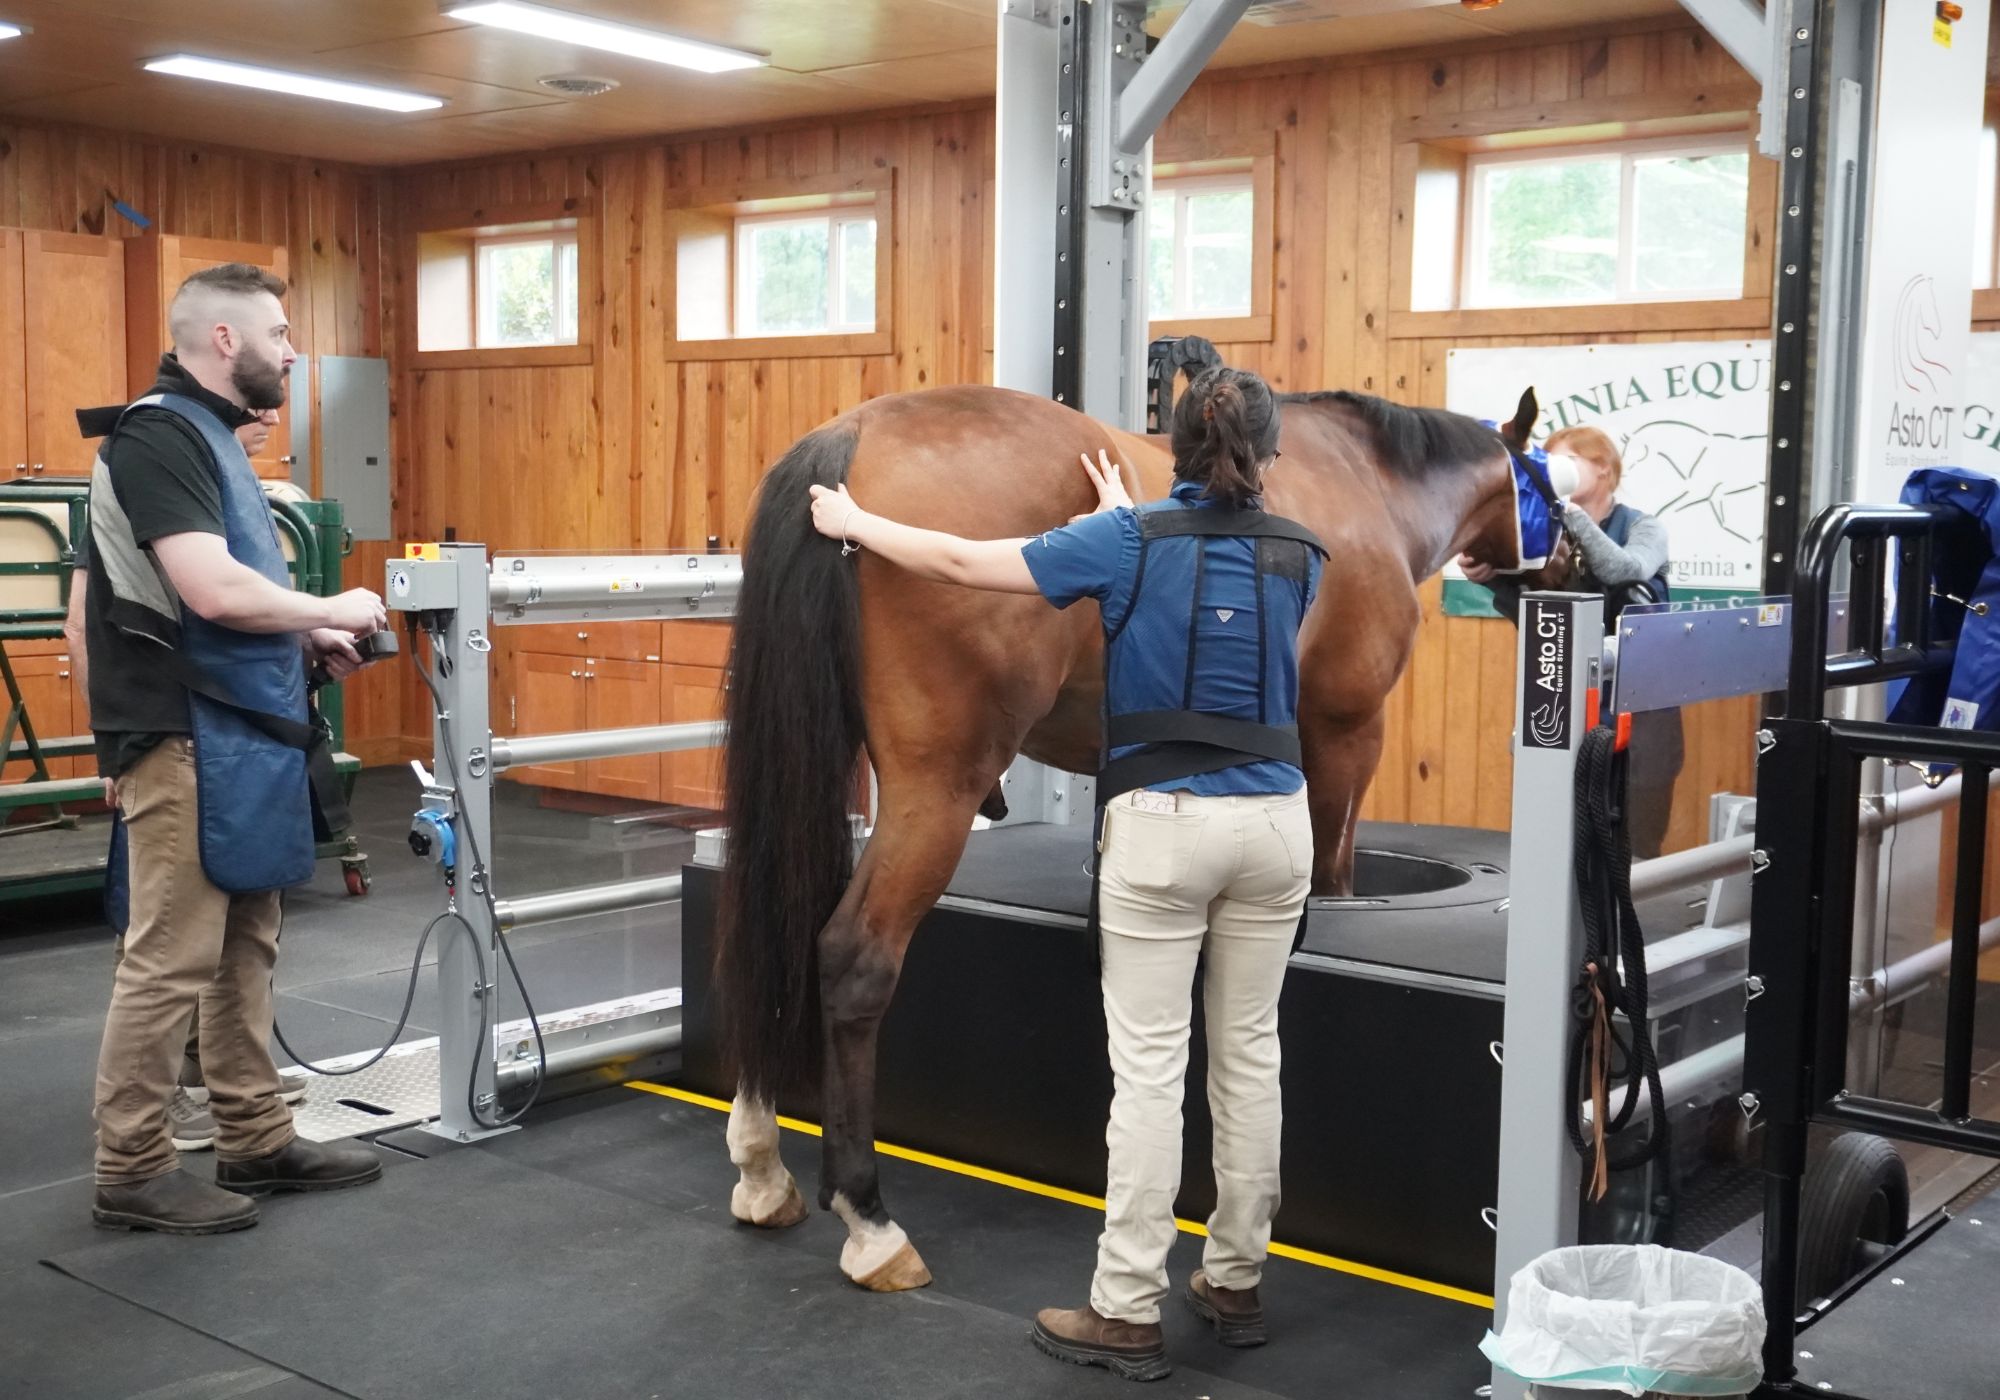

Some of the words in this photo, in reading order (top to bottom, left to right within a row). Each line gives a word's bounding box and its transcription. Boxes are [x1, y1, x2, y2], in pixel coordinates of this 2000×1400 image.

[1887, 401, 1925, 448] Asto
[1929, 405, 1954, 449] CT
[1558, 612, 1565, 623] CT
[1557, 626, 1565, 662] Standing
[1536, 642, 1556, 692] Asto
